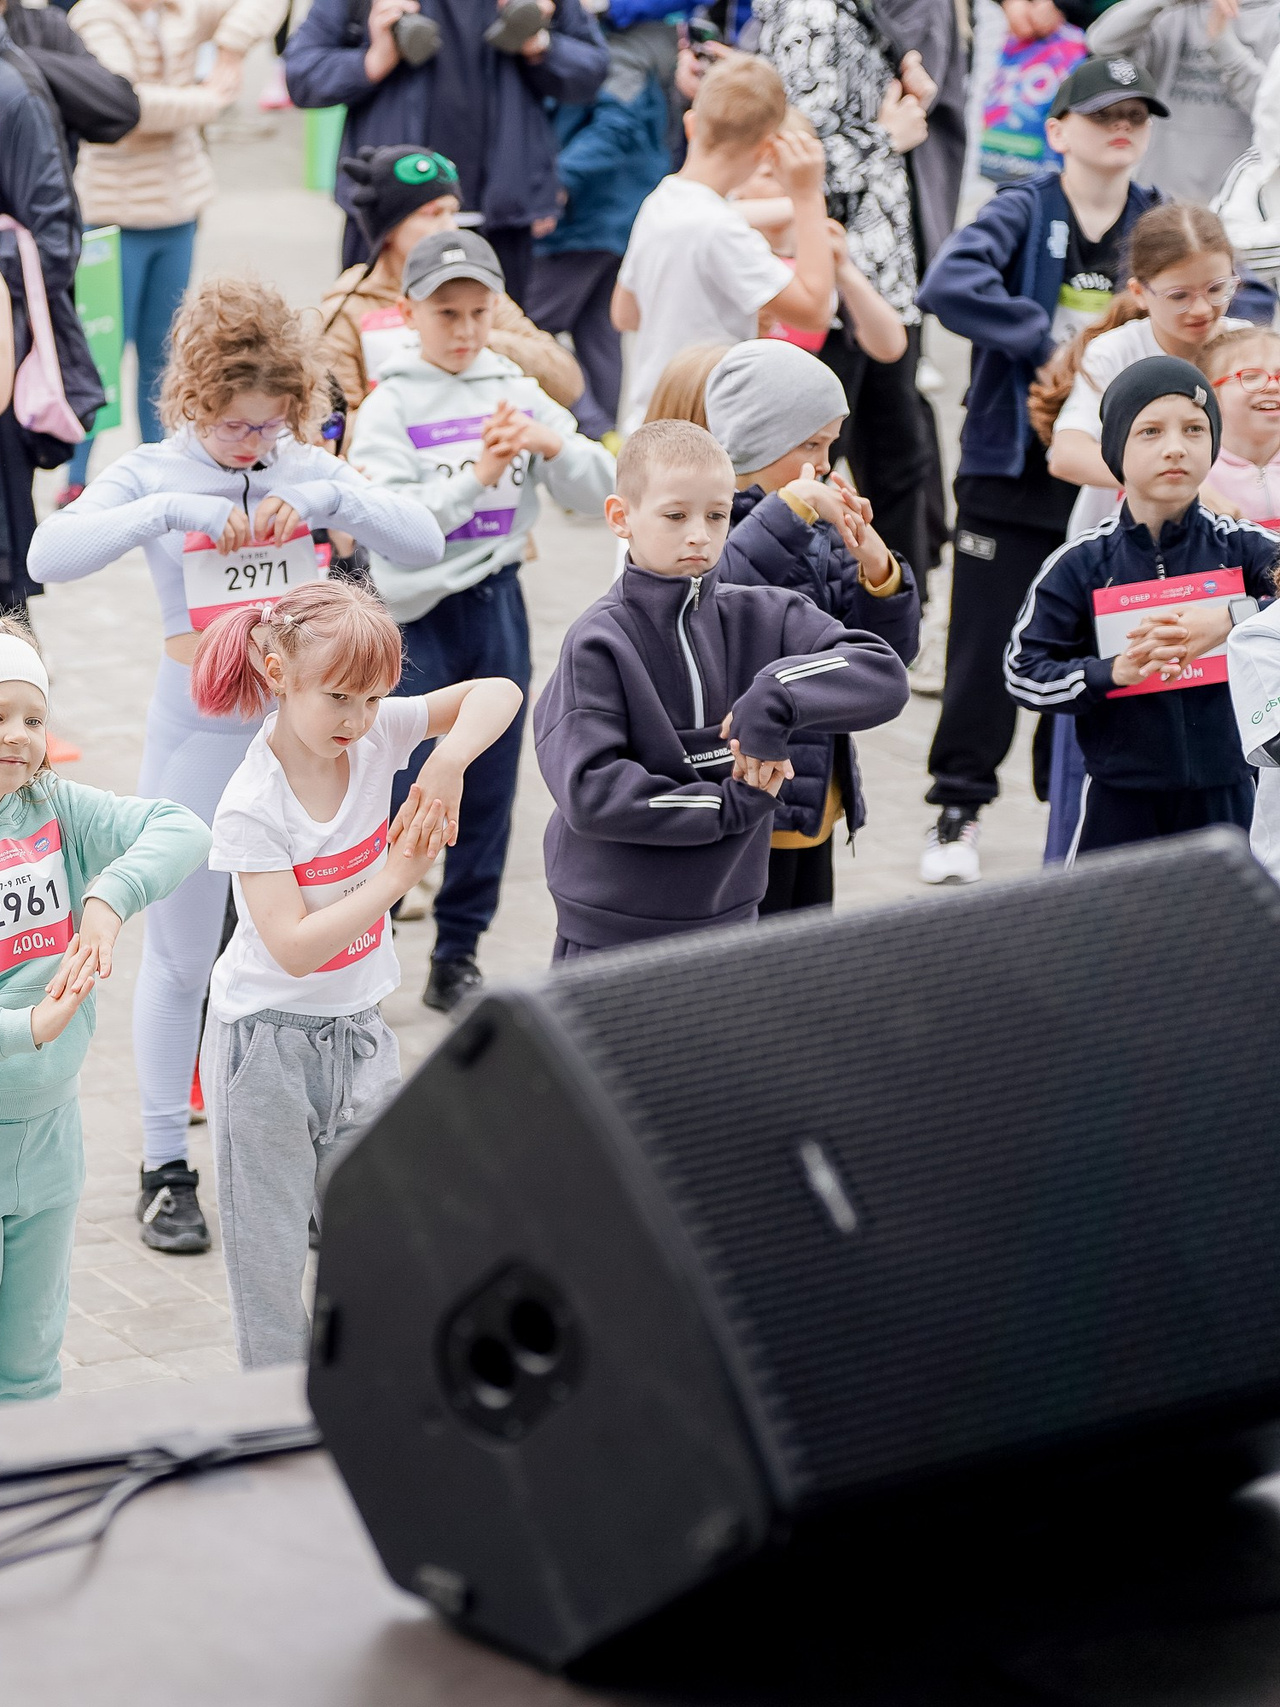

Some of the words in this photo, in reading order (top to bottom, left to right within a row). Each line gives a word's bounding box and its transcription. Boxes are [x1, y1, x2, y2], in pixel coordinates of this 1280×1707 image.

[225, 560, 288, 591] 2971
[691, 751, 713, 762] YOUR
[15, 874, 32, 886] ЛЕТ
[316, 866, 339, 877] СБЕР
[13, 932, 55, 956] 400м
[347, 932, 377, 956] 400м
